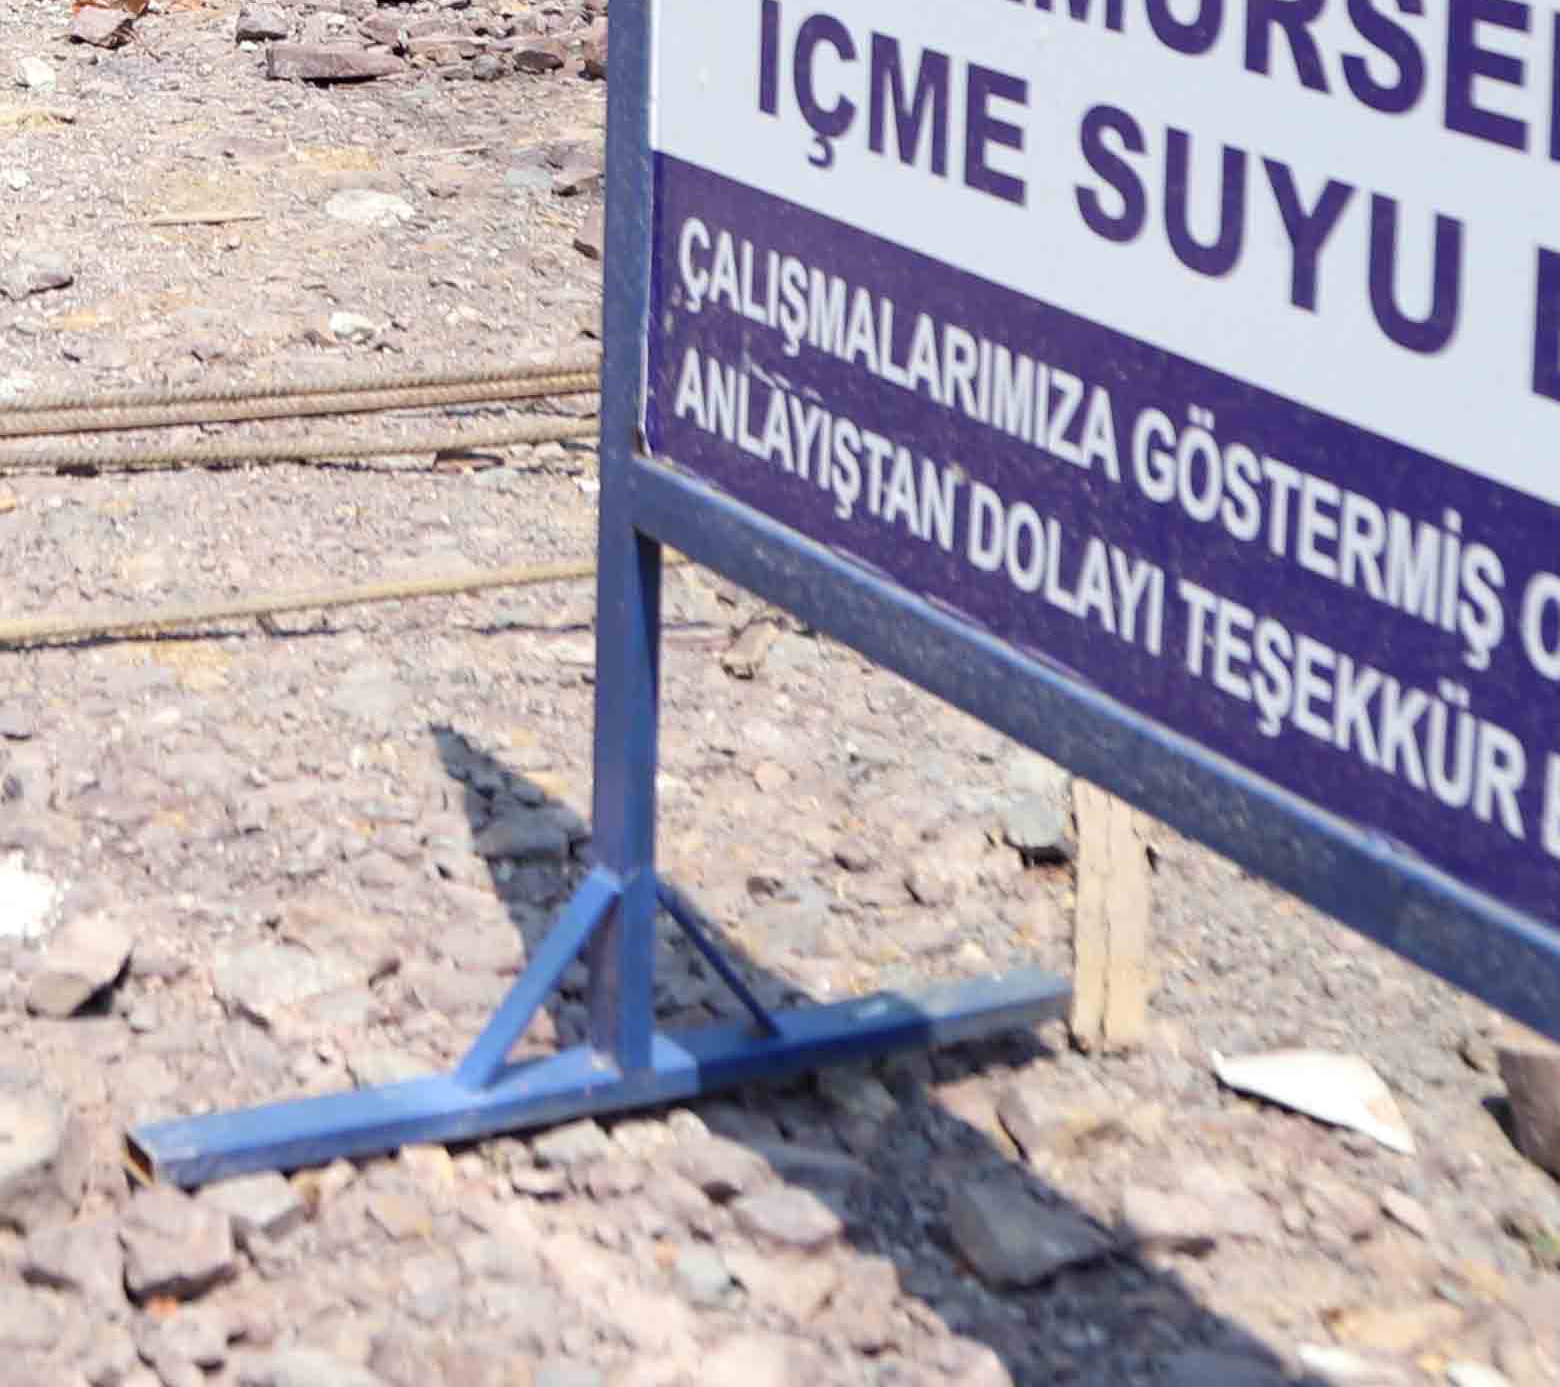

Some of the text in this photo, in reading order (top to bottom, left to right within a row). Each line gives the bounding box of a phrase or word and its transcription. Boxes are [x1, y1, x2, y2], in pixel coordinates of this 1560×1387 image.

[677, 216, 1122, 482] ÇALIŞMALARIMIZA
[1131, 407, 1506, 668] GÖSTERMİŞ
[1074, 103, 1464, 357] SUYU
[673, 346, 961, 552] ANLAYIŞTAN
[966, 480, 1165, 657] DOLAYI
[1177, 578, 1527, 838] TEŞEKKÜR
